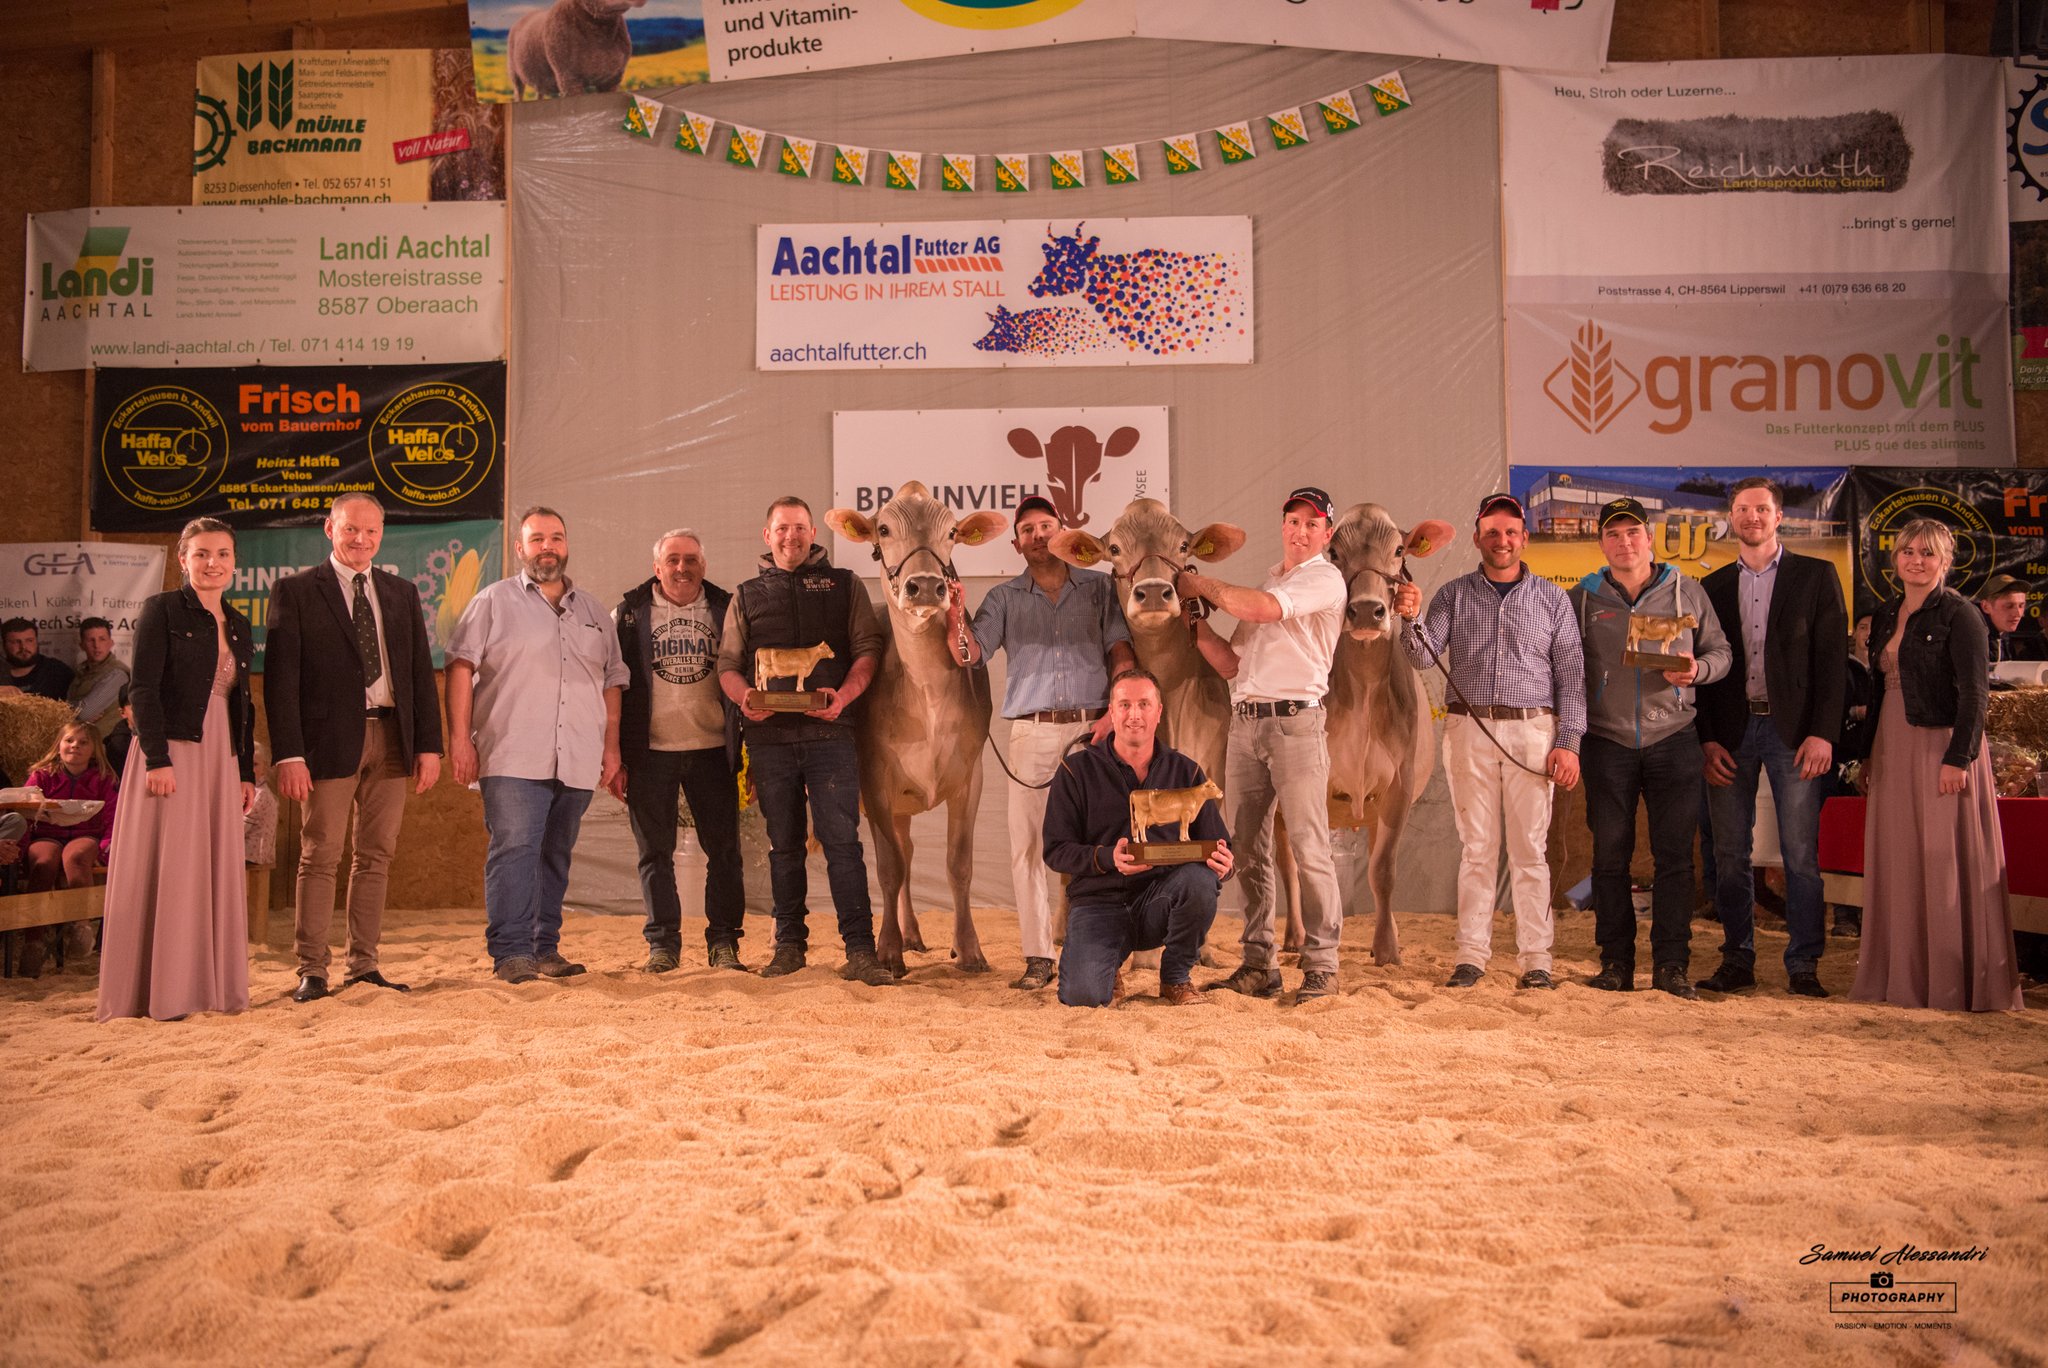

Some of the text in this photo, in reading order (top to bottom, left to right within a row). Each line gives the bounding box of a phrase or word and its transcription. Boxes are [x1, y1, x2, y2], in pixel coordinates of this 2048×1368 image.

[724, 3, 858, 33] und Vitamin-
[728, 36, 823, 67] produkte
[1554, 85, 1737, 99] Heu, Stroh oder Luzerne...
[295, 115, 367, 133] MÜHLE
[247, 137, 362, 155] BACHMANN
[398, 135, 463, 158] voll Natur
[1617, 145, 1886, 189] Reichmuth
[203, 178, 392, 194] 8253 Diessenhofen Tel. 052 657 41 51
[1723, 177, 1885, 189] Landesprodukte GmbH
[1911, 215, 1956, 231] gerne!
[319, 233, 490, 261] Landi Aachtal
[771, 235, 1001, 276] Aachtal Futter AG
[41, 257, 154, 300] Landi
[319, 269, 482, 287] Mostereistrasse
[770, 280, 1006, 301] LEISTUNG IN IHREM STALL
[1598, 282, 1906, 297] Poststrasse 4, CH-8564 Lipperswil +41 (0)79 636 68 20
[41, 303, 153, 322] AACHTAL
[318, 295, 478, 315] 8587 Oberaach
[90, 339, 255, 355] www.landi-aachtal.ch
[269, 338, 295, 353] Tel.
[301, 338, 329, 352] 071
[335, 337, 364, 351] 414
[372, 337, 390, 351] 19
[396, 337, 414, 350] 19
[770, 341, 927, 362] aachtalfutter.ch
[1645, 333, 1983, 435] granovit
[239, 383, 361, 414] Frisch
[380, 388, 486, 425] Eckartshausen b. Andwil
[112, 391, 219, 429] Eckartshausen b. Andwil
[241, 418, 362, 432] vom Bauernhof
[1766, 420, 1985, 437] Das Futterkonzept mit dem PLUS
[121, 433, 172, 449] Haffa
[388, 428, 440, 445] Haffa
[404, 446, 455, 462] Velos
[1835, 439, 1986, 453] PLUS que des aliments
[136, 451, 188, 466] Velos
[256, 455, 340, 469] Heinz Haffa
[281, 470, 313, 481] Velos
[250, 481, 375, 494] Eckartshausen/Andwil
[401, 485, 461, 501] haffa-velo.ch
[134, 490, 191, 505] haffa-velo.ch
[227, 498, 255, 510] Tel.
[259, 498, 286, 510] 071
[292, 497, 320, 509] 648
[856, 483, 1040, 512] BRNVIEH
[1870, 493, 1985, 532] Eckartshausen b. Andwil
[2008, 525, 2044, 536] vom
[24, 552, 96, 576] GEA
[0, 597, 30, 609] elken
[46, 596, 81, 608] Kühlen
[652, 638, 719, 660] RIGINAL
